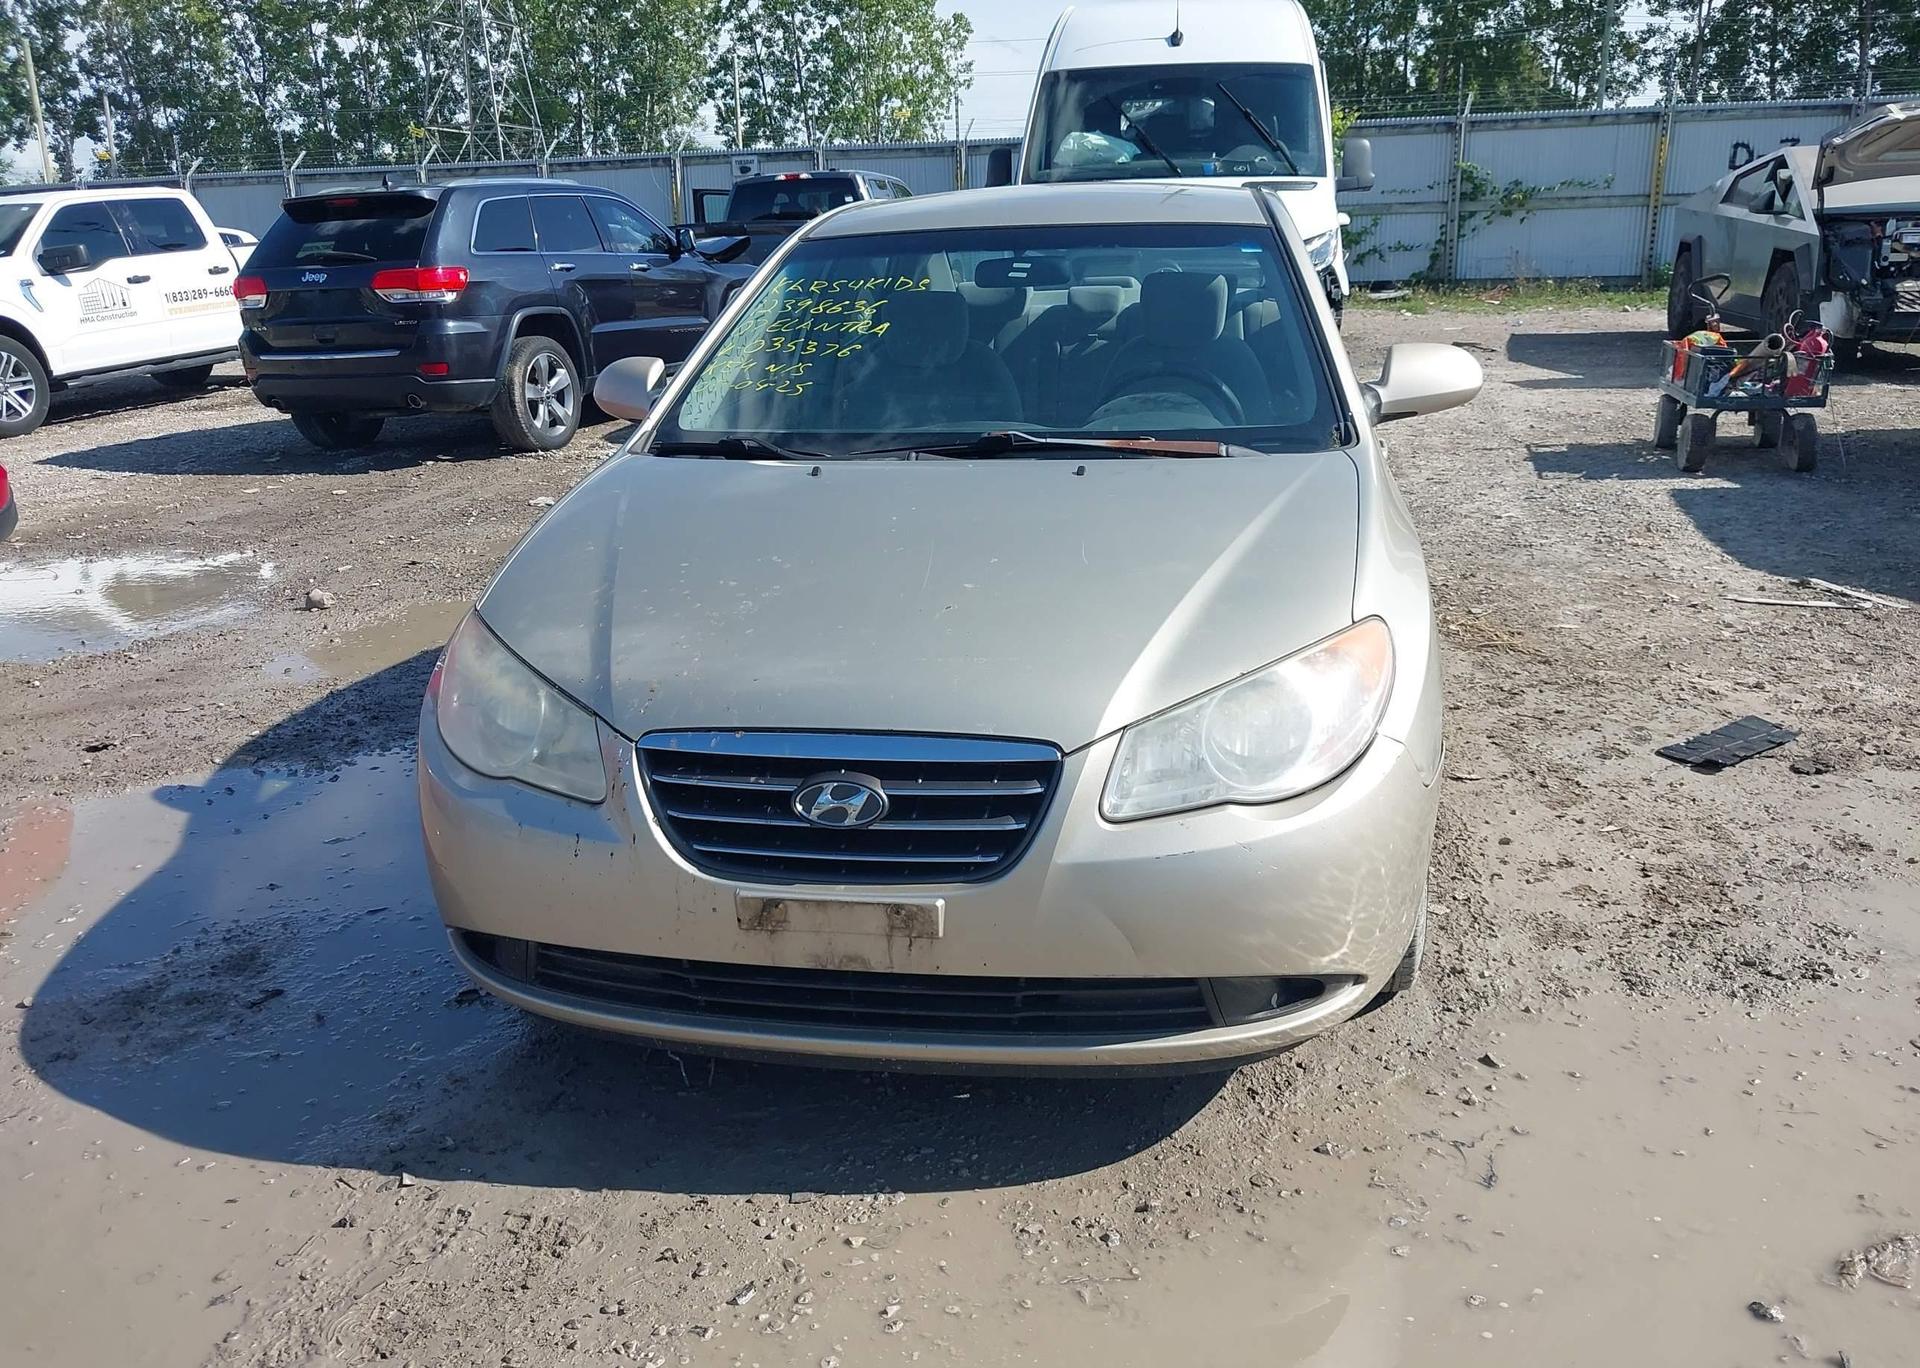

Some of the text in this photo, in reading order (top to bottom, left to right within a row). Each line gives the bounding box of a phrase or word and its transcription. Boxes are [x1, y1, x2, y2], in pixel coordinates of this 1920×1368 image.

[301, 271, 327, 283] Jeep
[79, 310, 138, 325] HMA Construction
